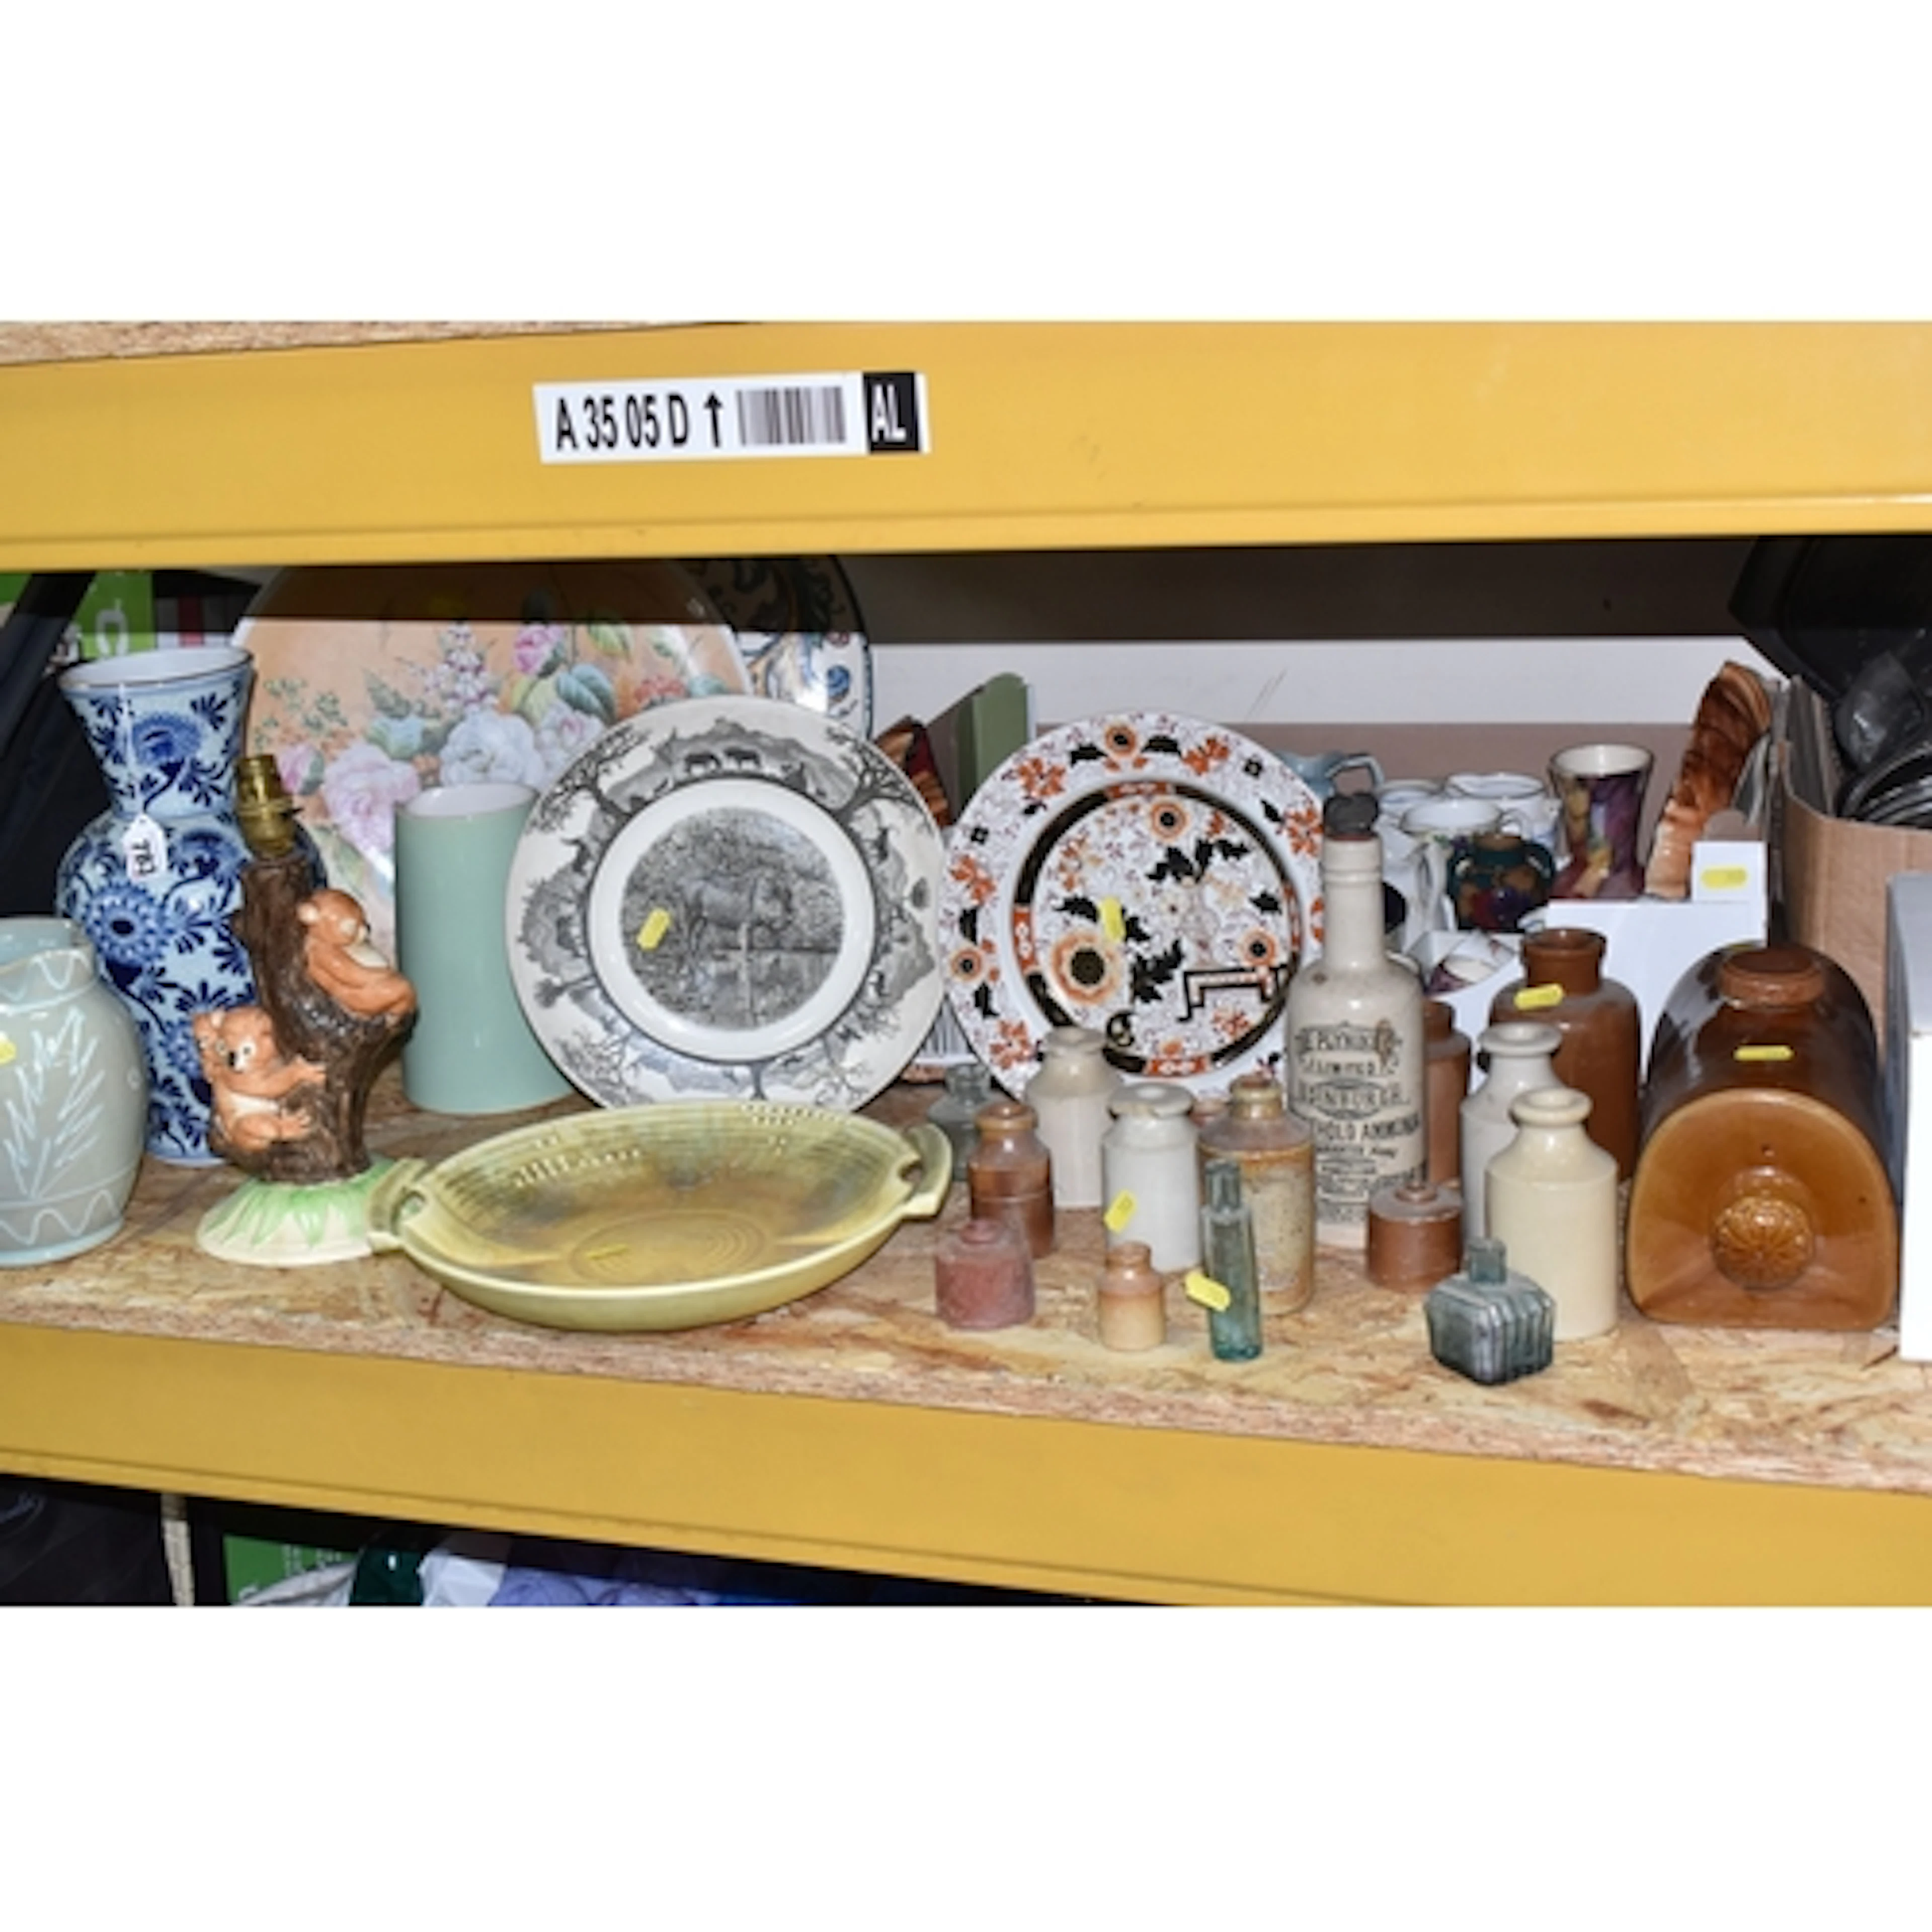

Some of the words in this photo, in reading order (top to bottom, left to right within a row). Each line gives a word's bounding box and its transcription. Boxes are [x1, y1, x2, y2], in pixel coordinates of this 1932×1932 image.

[556, 397, 578, 451] A
[584, 394, 619, 449] 35
[625, 392, 661, 448] 05
[668, 392, 689, 446] D
[871, 384, 906, 443] AL
